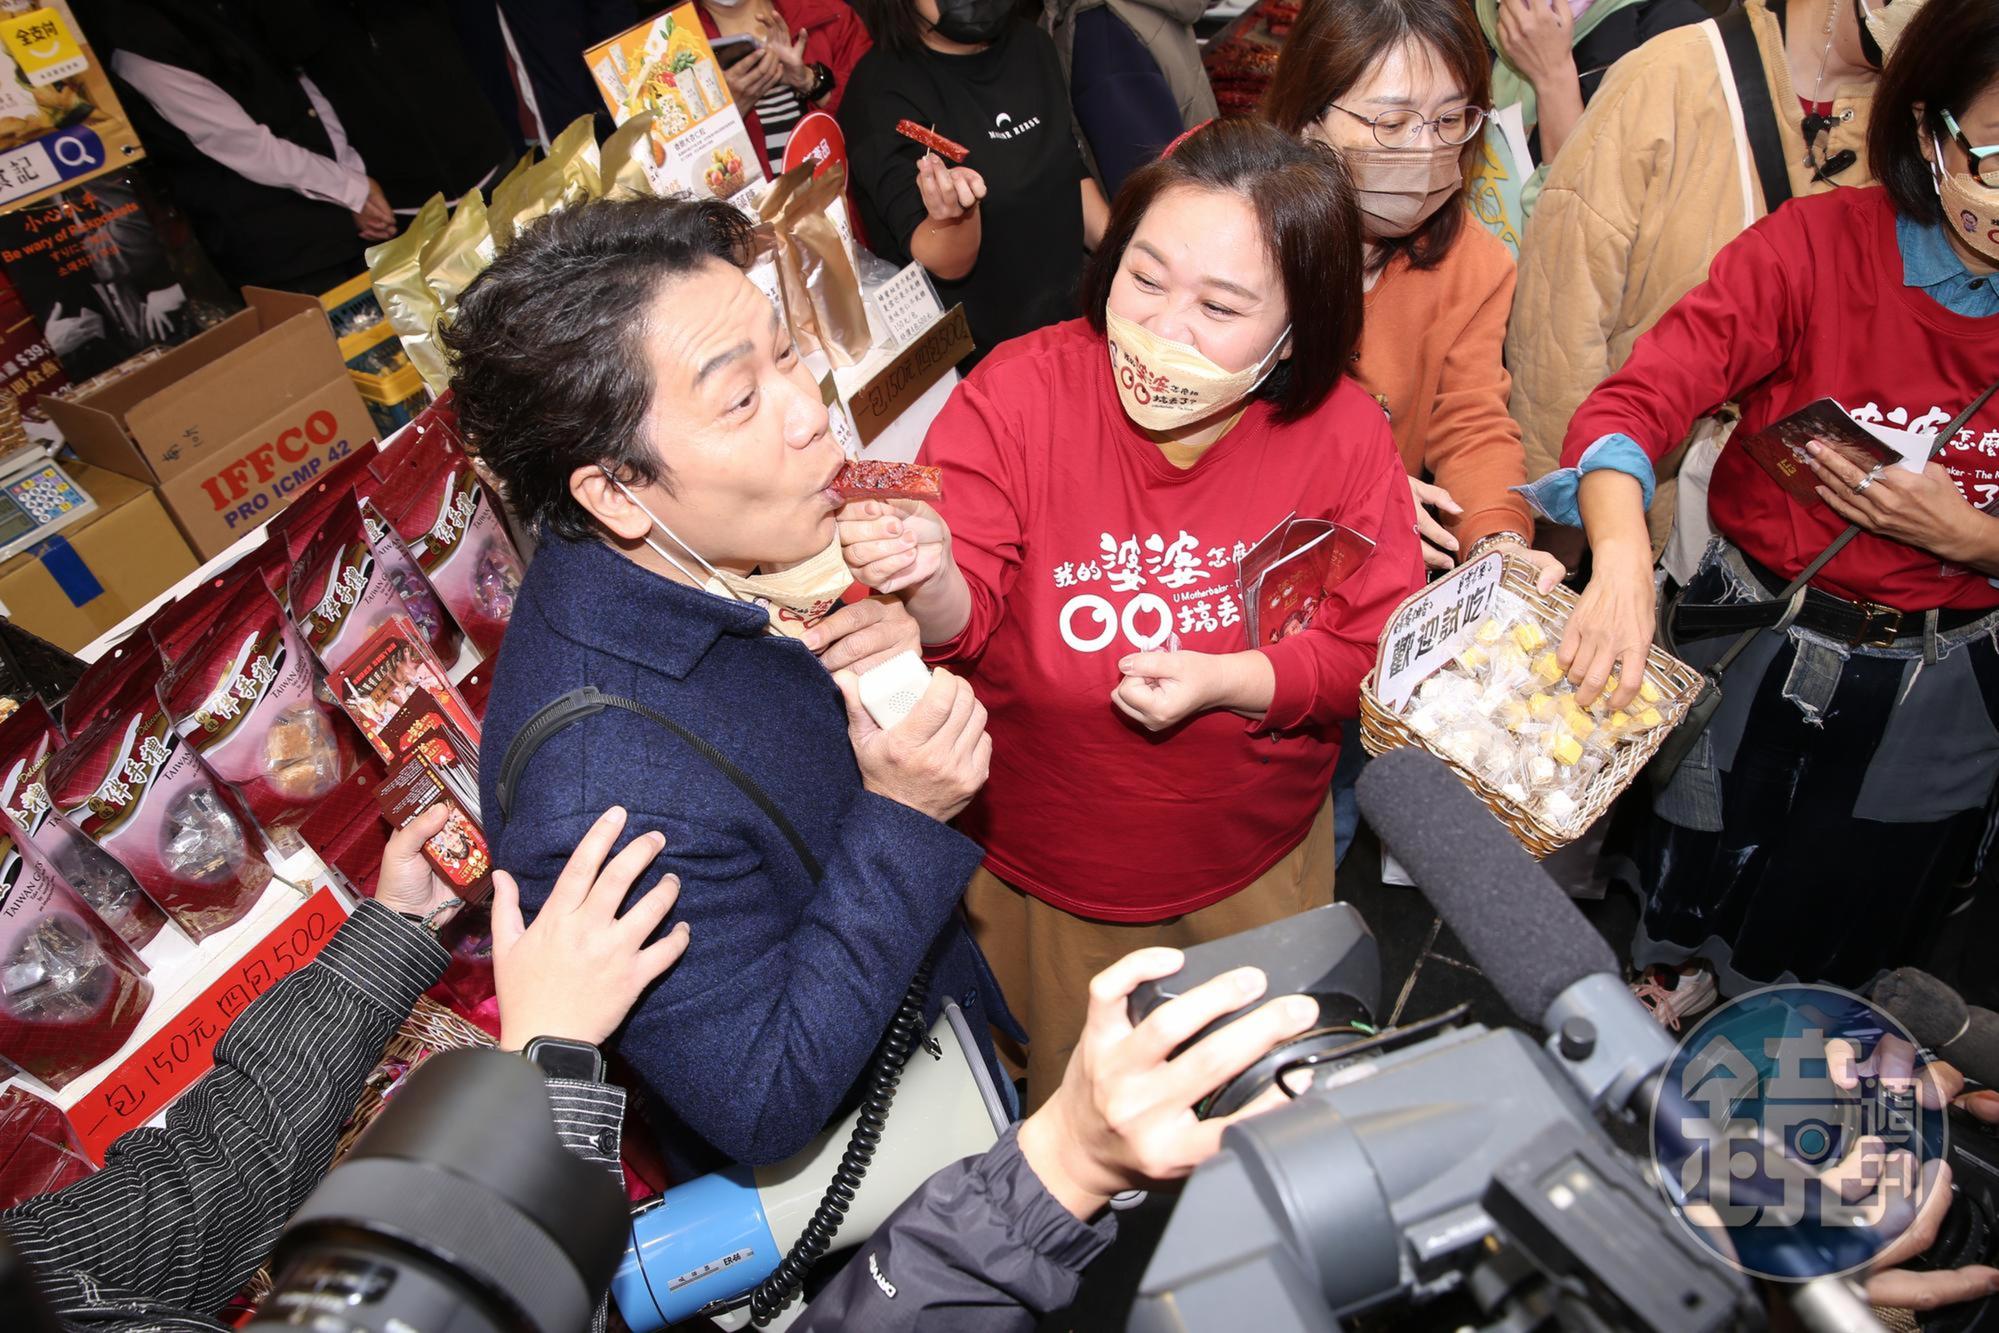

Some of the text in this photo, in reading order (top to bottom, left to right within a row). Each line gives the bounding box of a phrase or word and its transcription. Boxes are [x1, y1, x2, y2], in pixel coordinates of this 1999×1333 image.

[2, 249, 21, 263] Be
[23, 236, 53, 256] wary
[55, 228, 68, 242] of
[201, 410, 338, 511] IFFCO
[224, 439, 352, 529] PRO ICMP 42
[436, 491, 476, 544] 伴手禮
[321, 565, 369, 622] 伴手禮
[364, 581, 384, 605] TAIWAN
[212, 655, 277, 719] 伴手禮
[270, 669, 297, 699] TAIWAN
[102, 736, 172, 806] 伴手禮
[3, 882, 37, 919] TAIWAN
